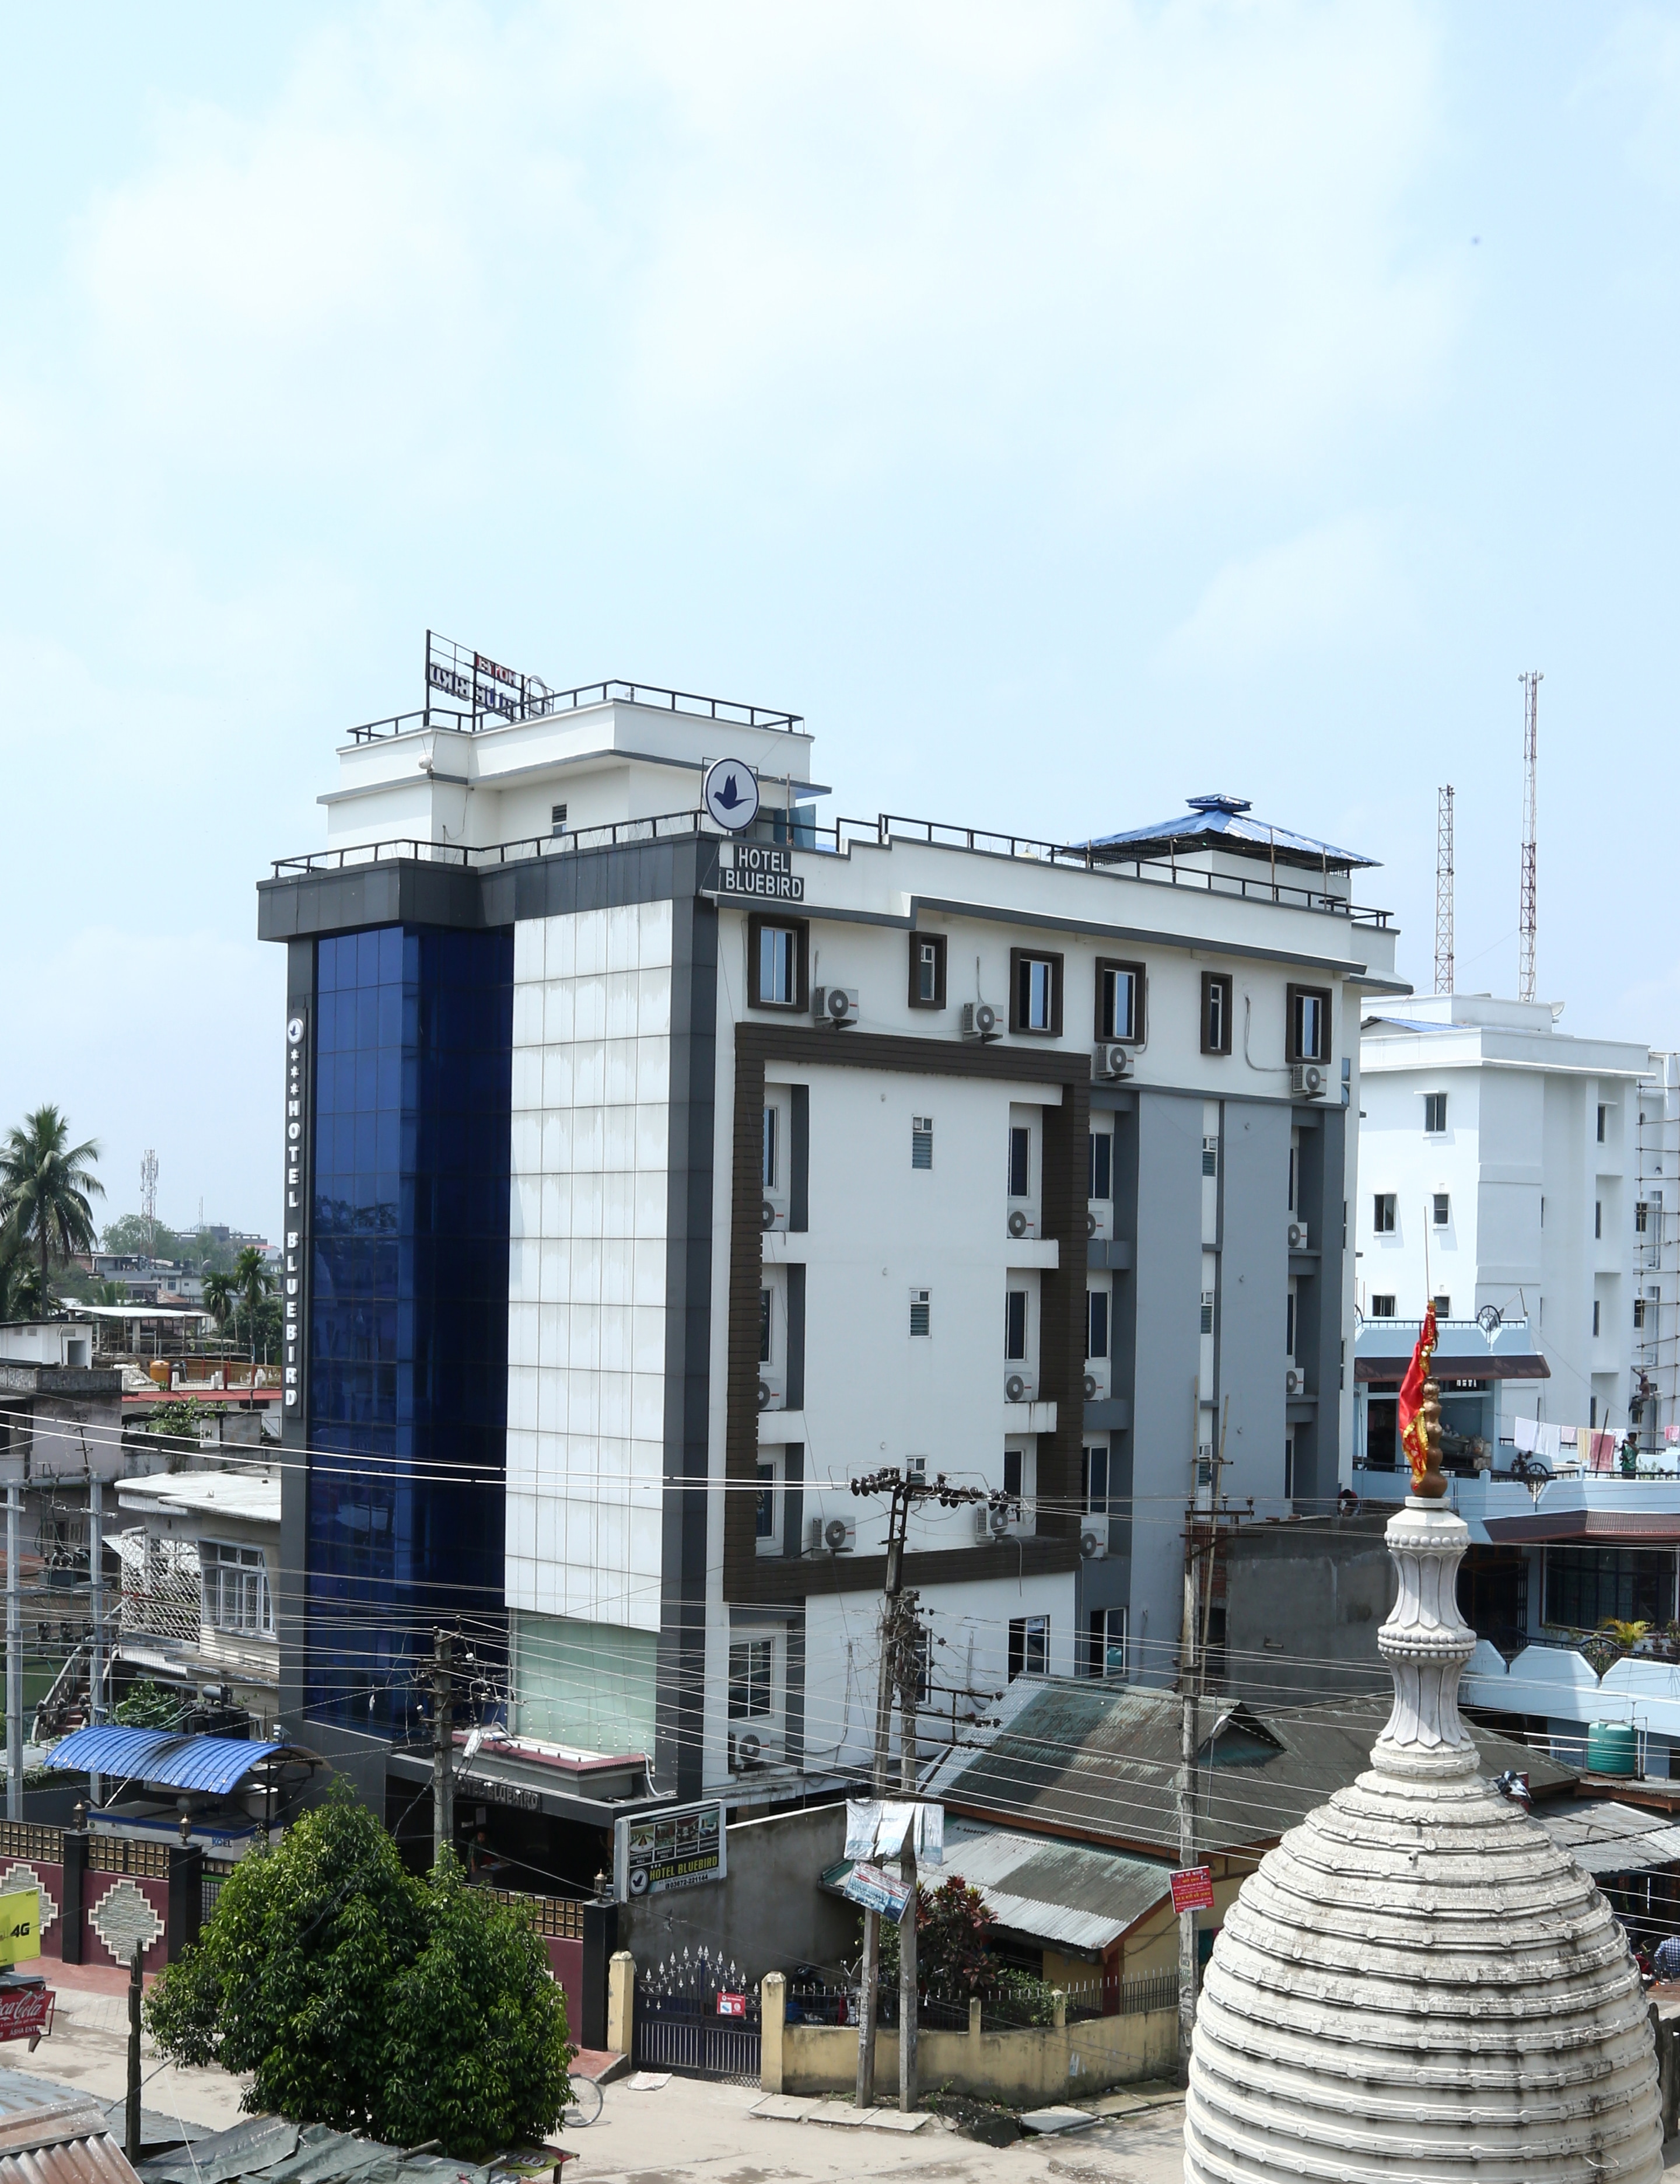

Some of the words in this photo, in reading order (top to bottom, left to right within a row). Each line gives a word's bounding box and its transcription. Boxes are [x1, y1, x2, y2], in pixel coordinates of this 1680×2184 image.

[738, 847, 789, 873] HOTEL
[726, 869, 802, 898] BLUEBIRD
[288, 1100, 300, 1208] HOTEL
[286, 1231, 299, 1406] BLUEBIRD
[487, 1782, 538, 1810] BLUEBIRD
[650, 1866, 675, 1881] HOTEL
[678, 1856, 718, 1875] BLUEBIRD
[10, 1922, 30, 1938] 4G
